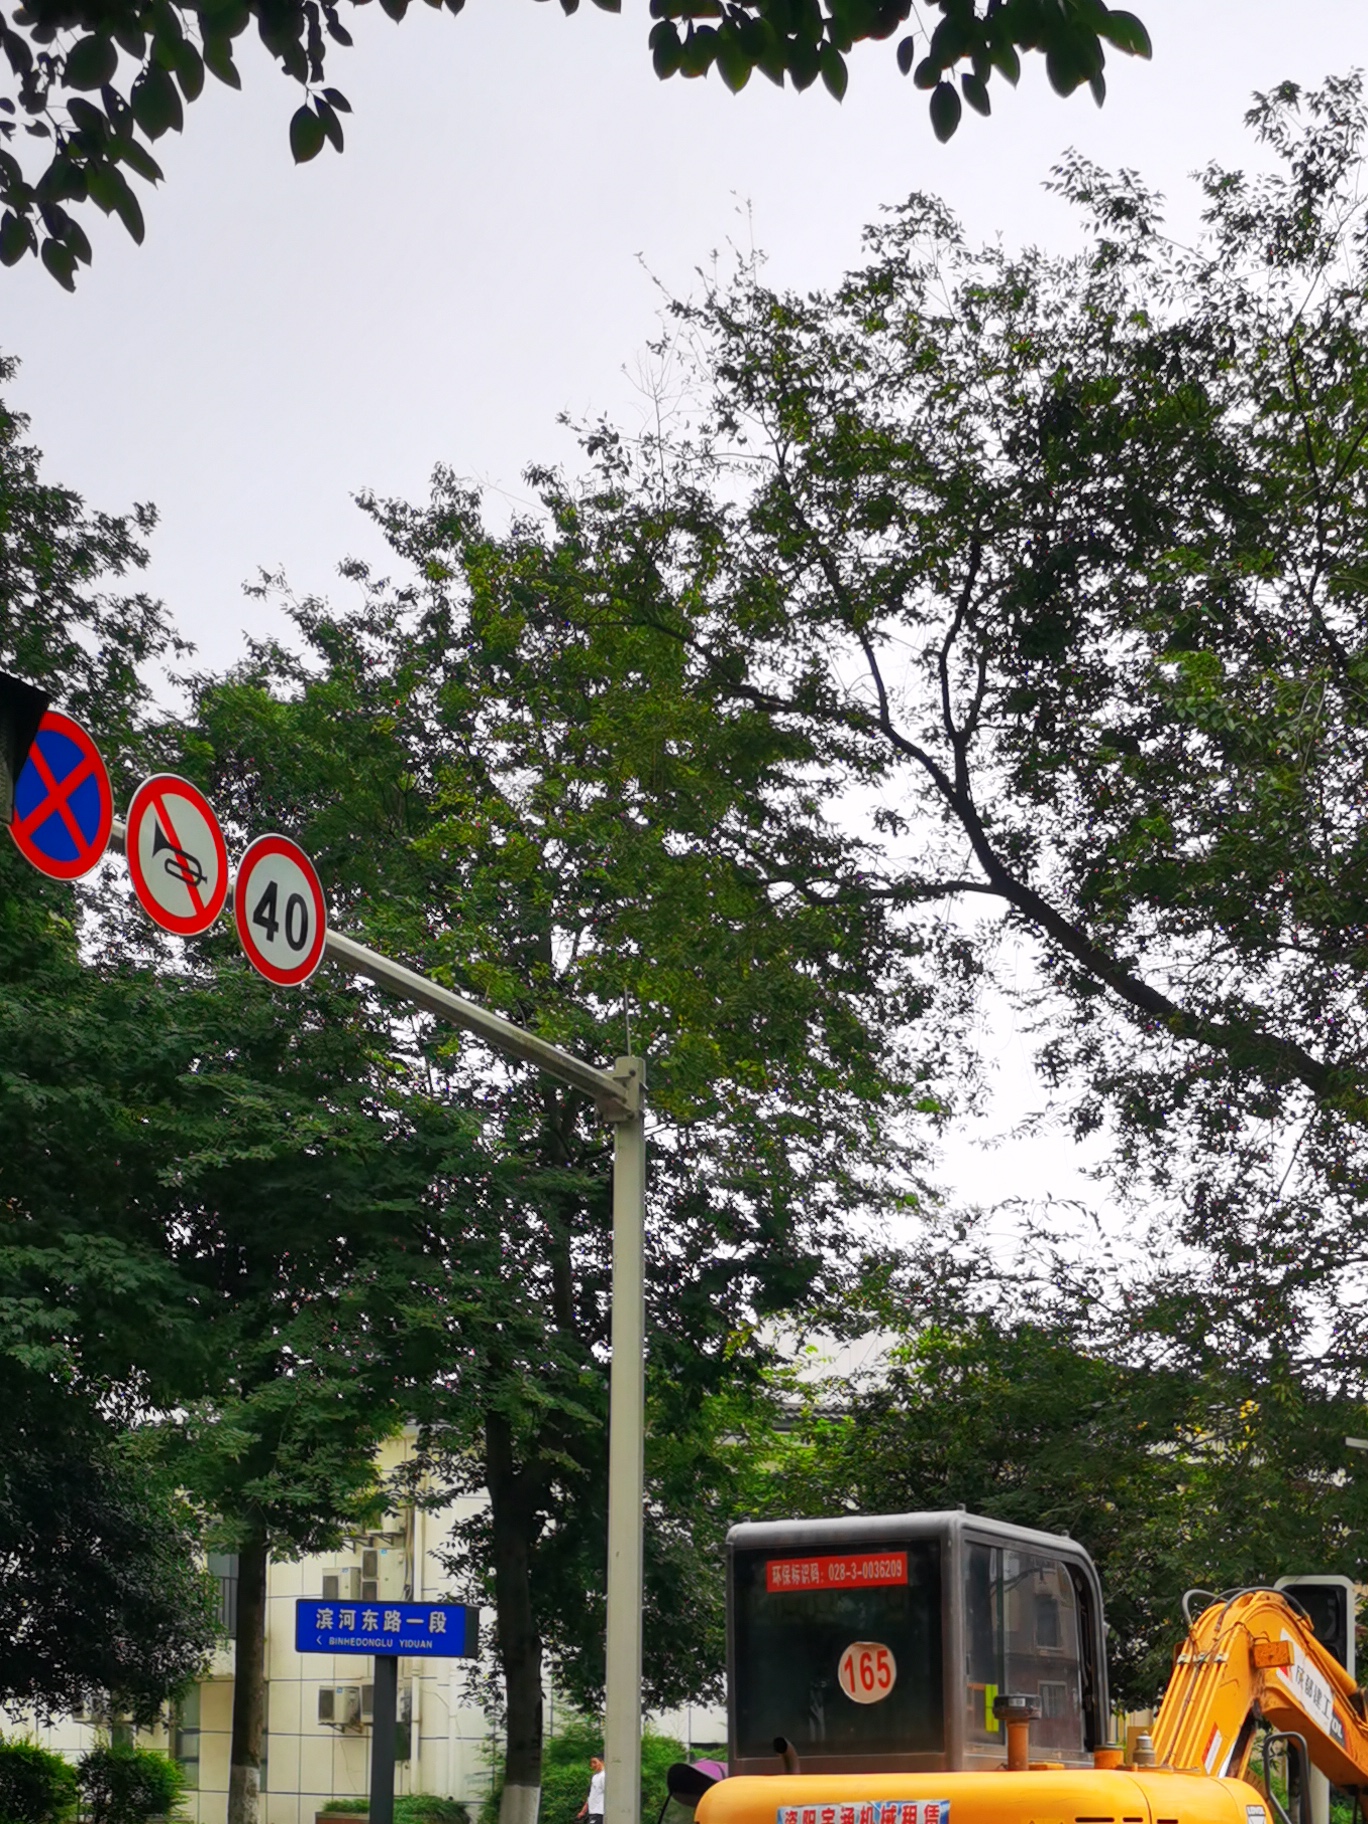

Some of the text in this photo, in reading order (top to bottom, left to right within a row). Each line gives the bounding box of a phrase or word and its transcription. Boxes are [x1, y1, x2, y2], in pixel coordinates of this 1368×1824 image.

[252, 880, 309, 952] 40
[828, 1559, 902, 1581] 028-3-0036209
[316, 1608, 447, 1634] 滨河东路一段
[329, 1636, 433, 1649] BINHEDONGLU YIDUAN
[844, 1650, 892, 1693] 165
